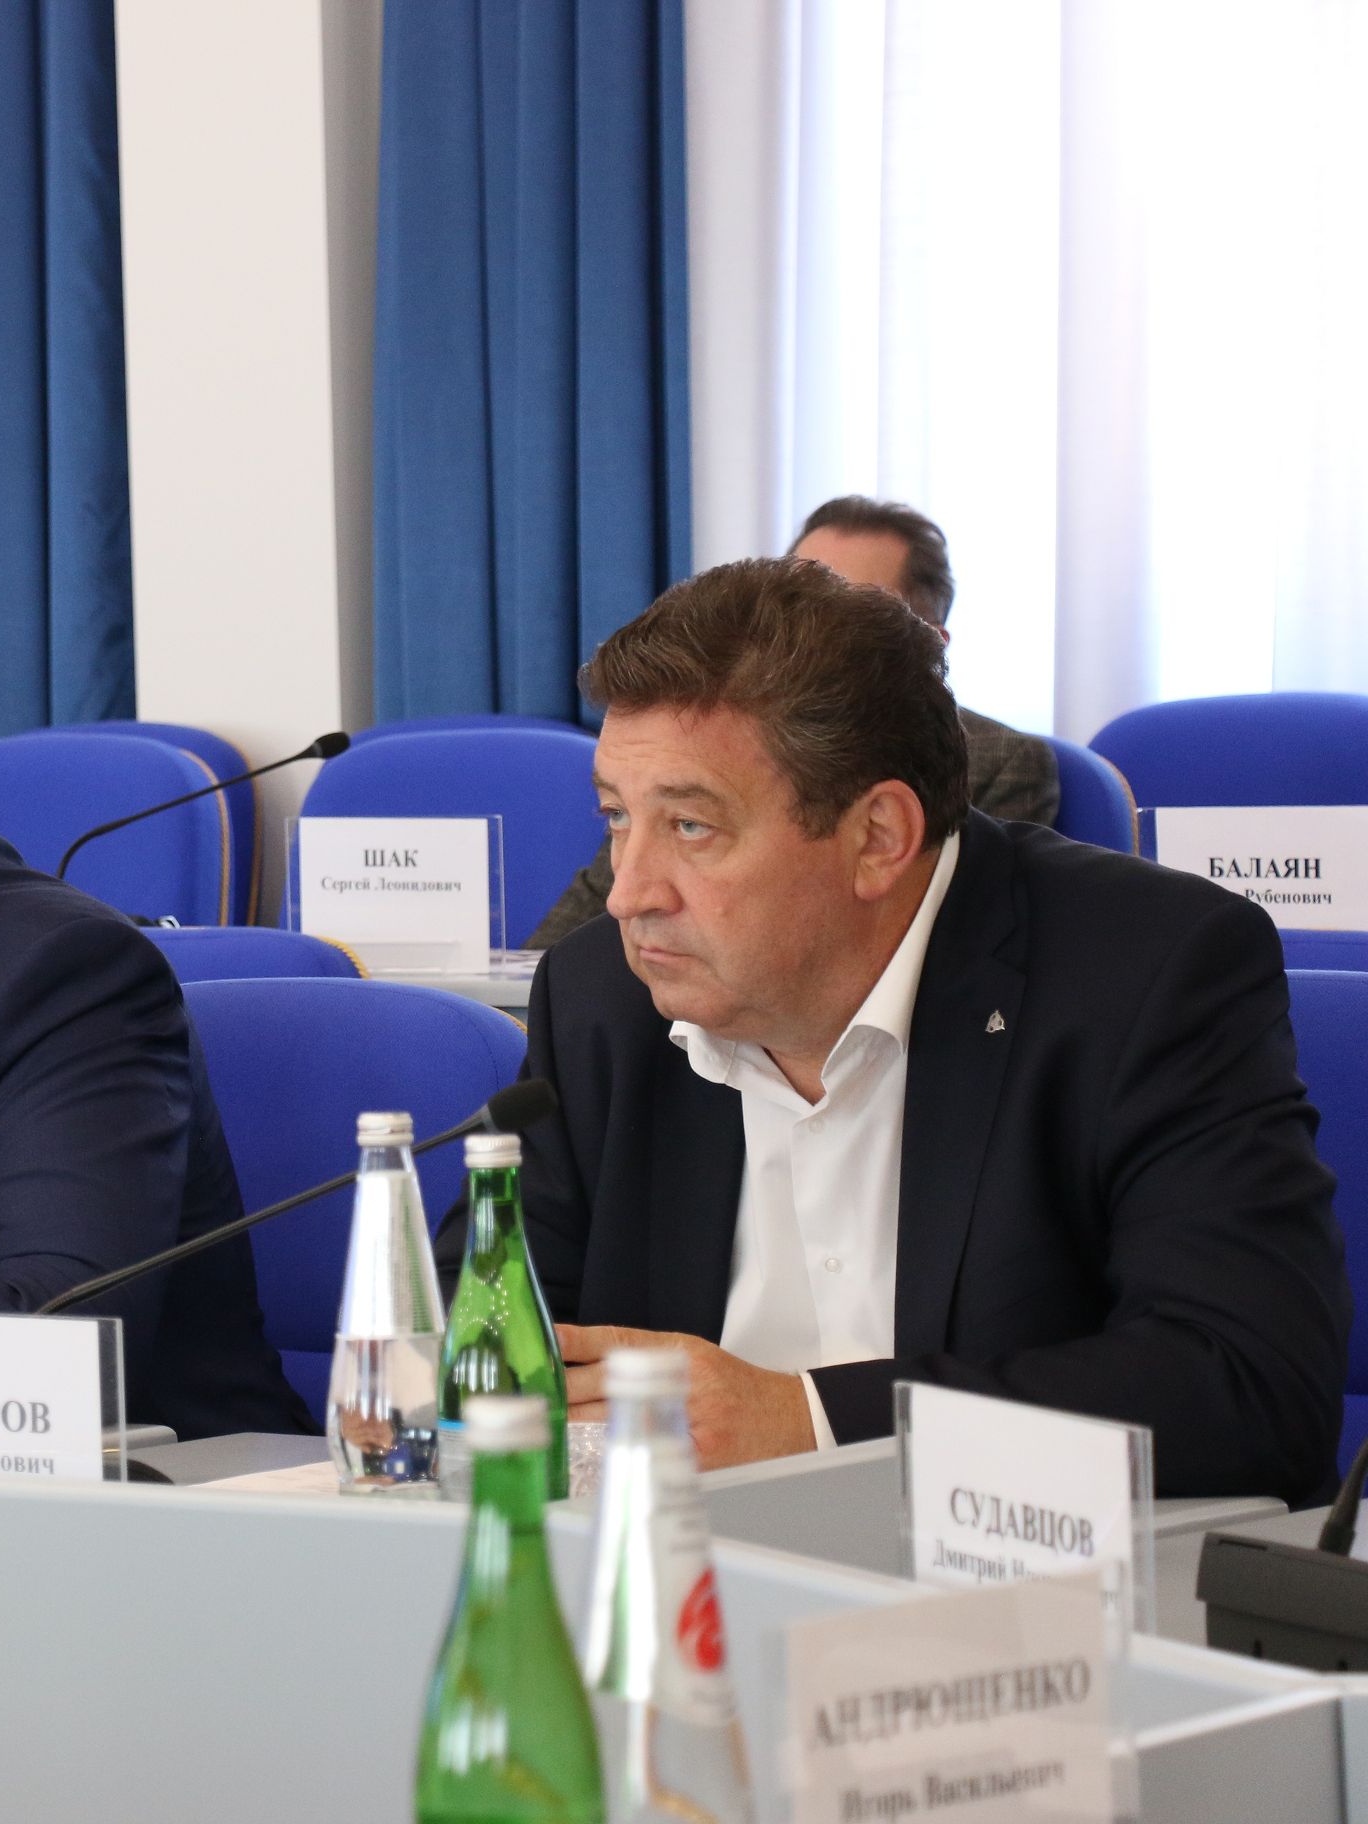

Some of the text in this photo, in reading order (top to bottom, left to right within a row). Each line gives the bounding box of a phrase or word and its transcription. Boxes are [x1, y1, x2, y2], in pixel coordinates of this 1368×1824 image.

[363, 849, 419, 868] ШАК
[1208, 857, 1322, 879] БАЛАЯН
[321, 876, 462, 893] Сергей Леонидович
[949, 1487, 1095, 1558] СУДАВЦОВ
[932, 1538, 1008, 1584] Дмитрий
[812, 1658, 1091, 1748] АНДРЮЩЕНКО
